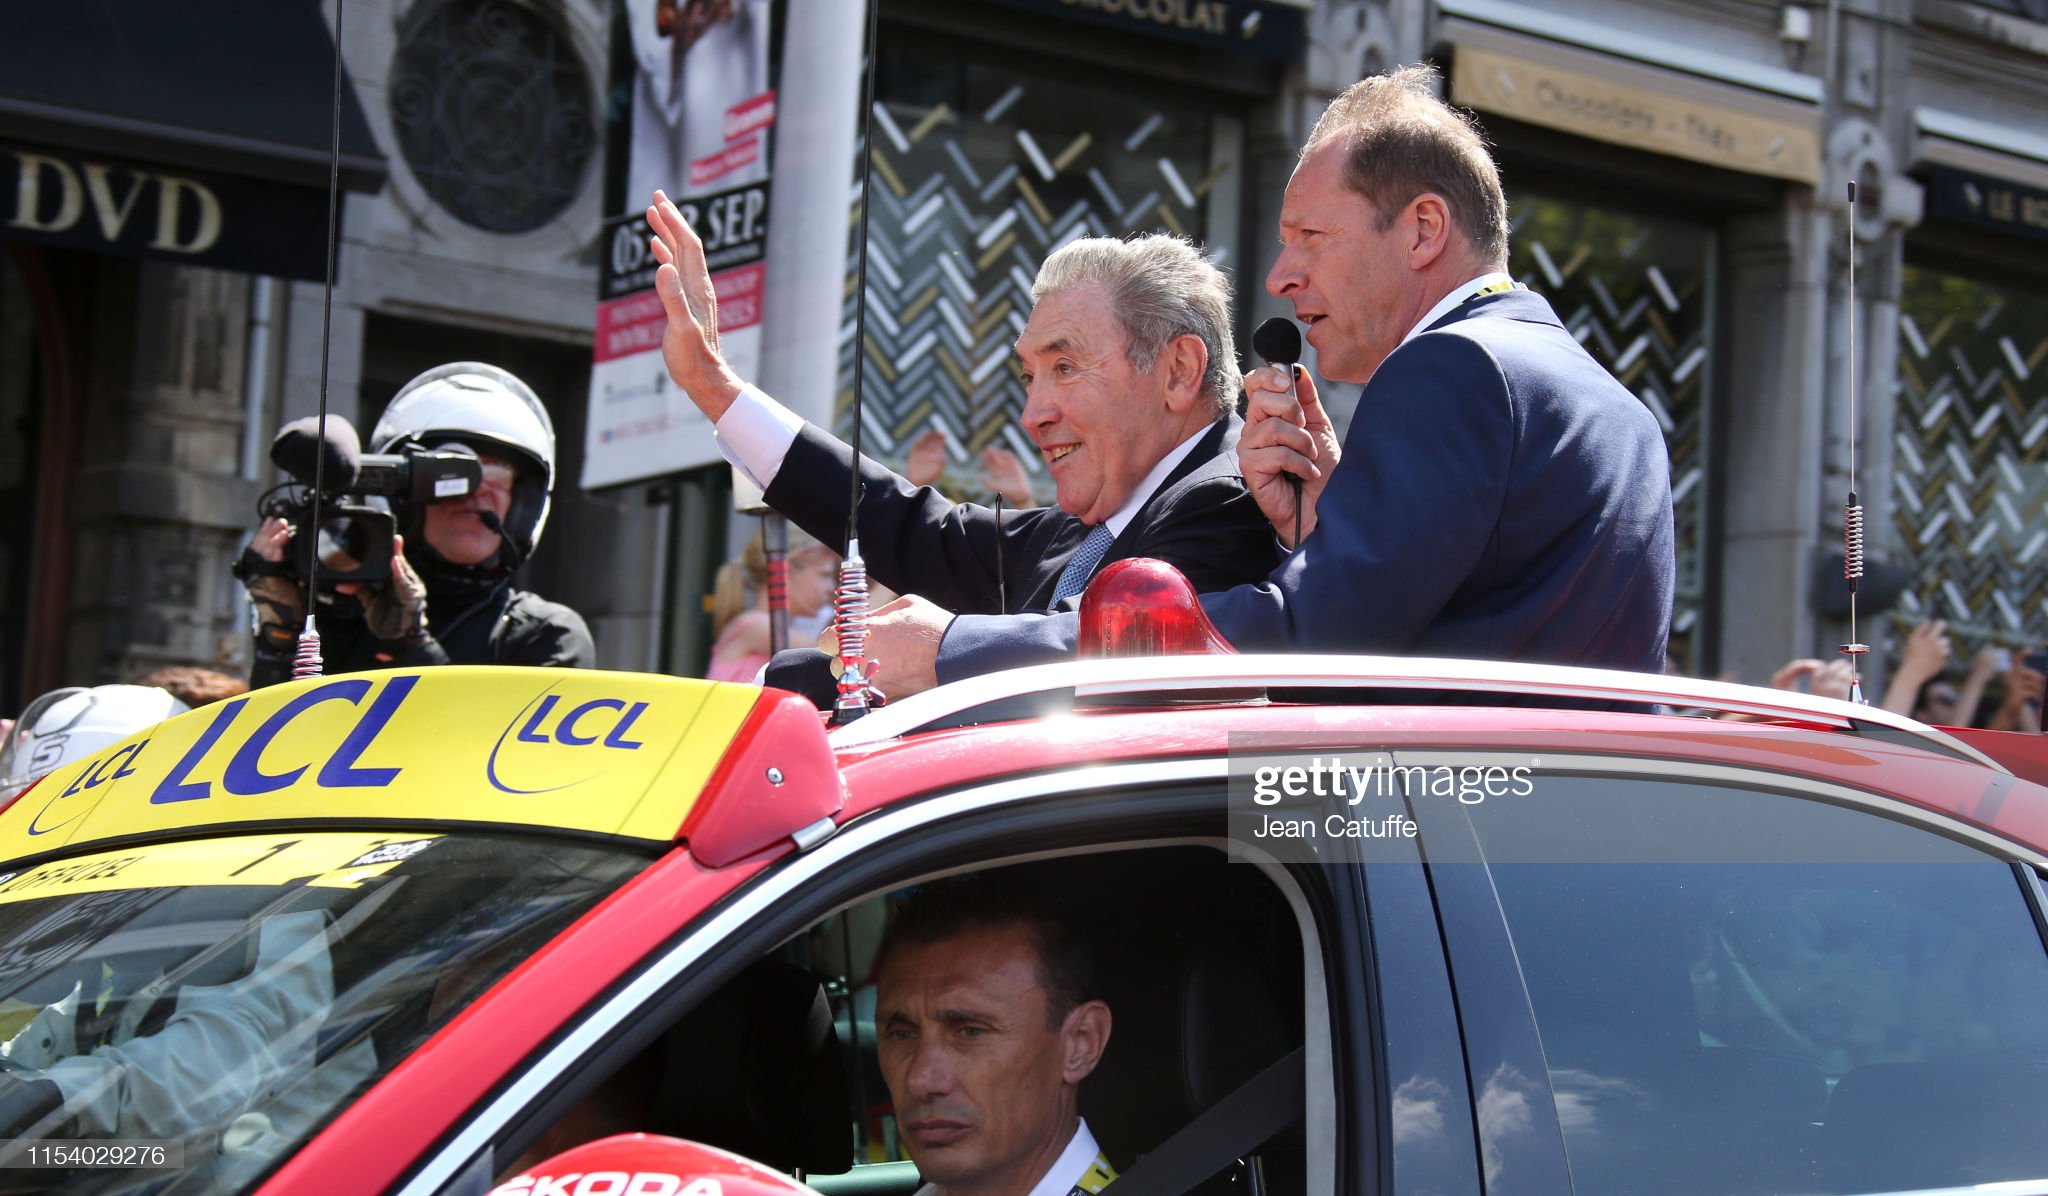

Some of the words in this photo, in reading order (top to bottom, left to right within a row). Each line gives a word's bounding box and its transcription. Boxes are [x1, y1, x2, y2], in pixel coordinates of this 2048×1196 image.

[1061, 0, 1227, 34] COLAT
[8, 152, 223, 254] DVD
[706, 188, 765, 250] SEP.
[150, 675, 421, 805] LCL
[517, 695, 649, 749] LCL
[61, 738, 151, 798] LCL
